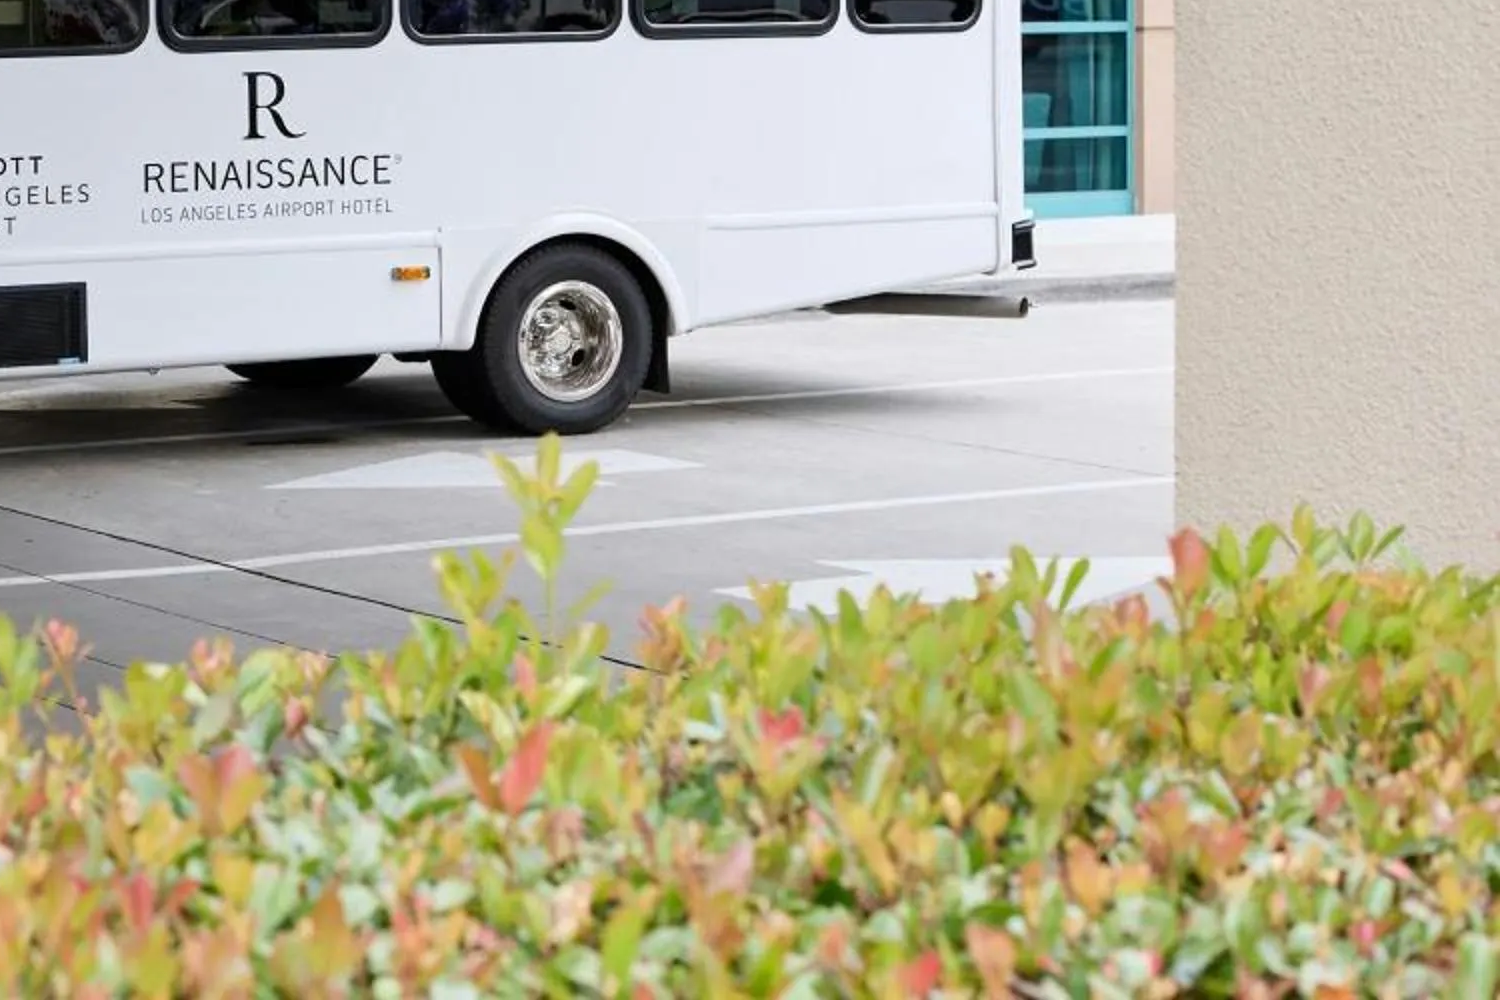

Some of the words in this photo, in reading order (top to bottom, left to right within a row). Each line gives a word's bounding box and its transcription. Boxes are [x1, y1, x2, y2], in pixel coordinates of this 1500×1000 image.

[243, 71, 306, 141] R
[143, 154, 392, 193] RENAISSANCE
[141, 207, 173, 224] LOS
[180, 202, 257, 222] ANGELES
[263, 199, 334, 217] AIRPORT
[341, 197, 393, 215] HOTEL
